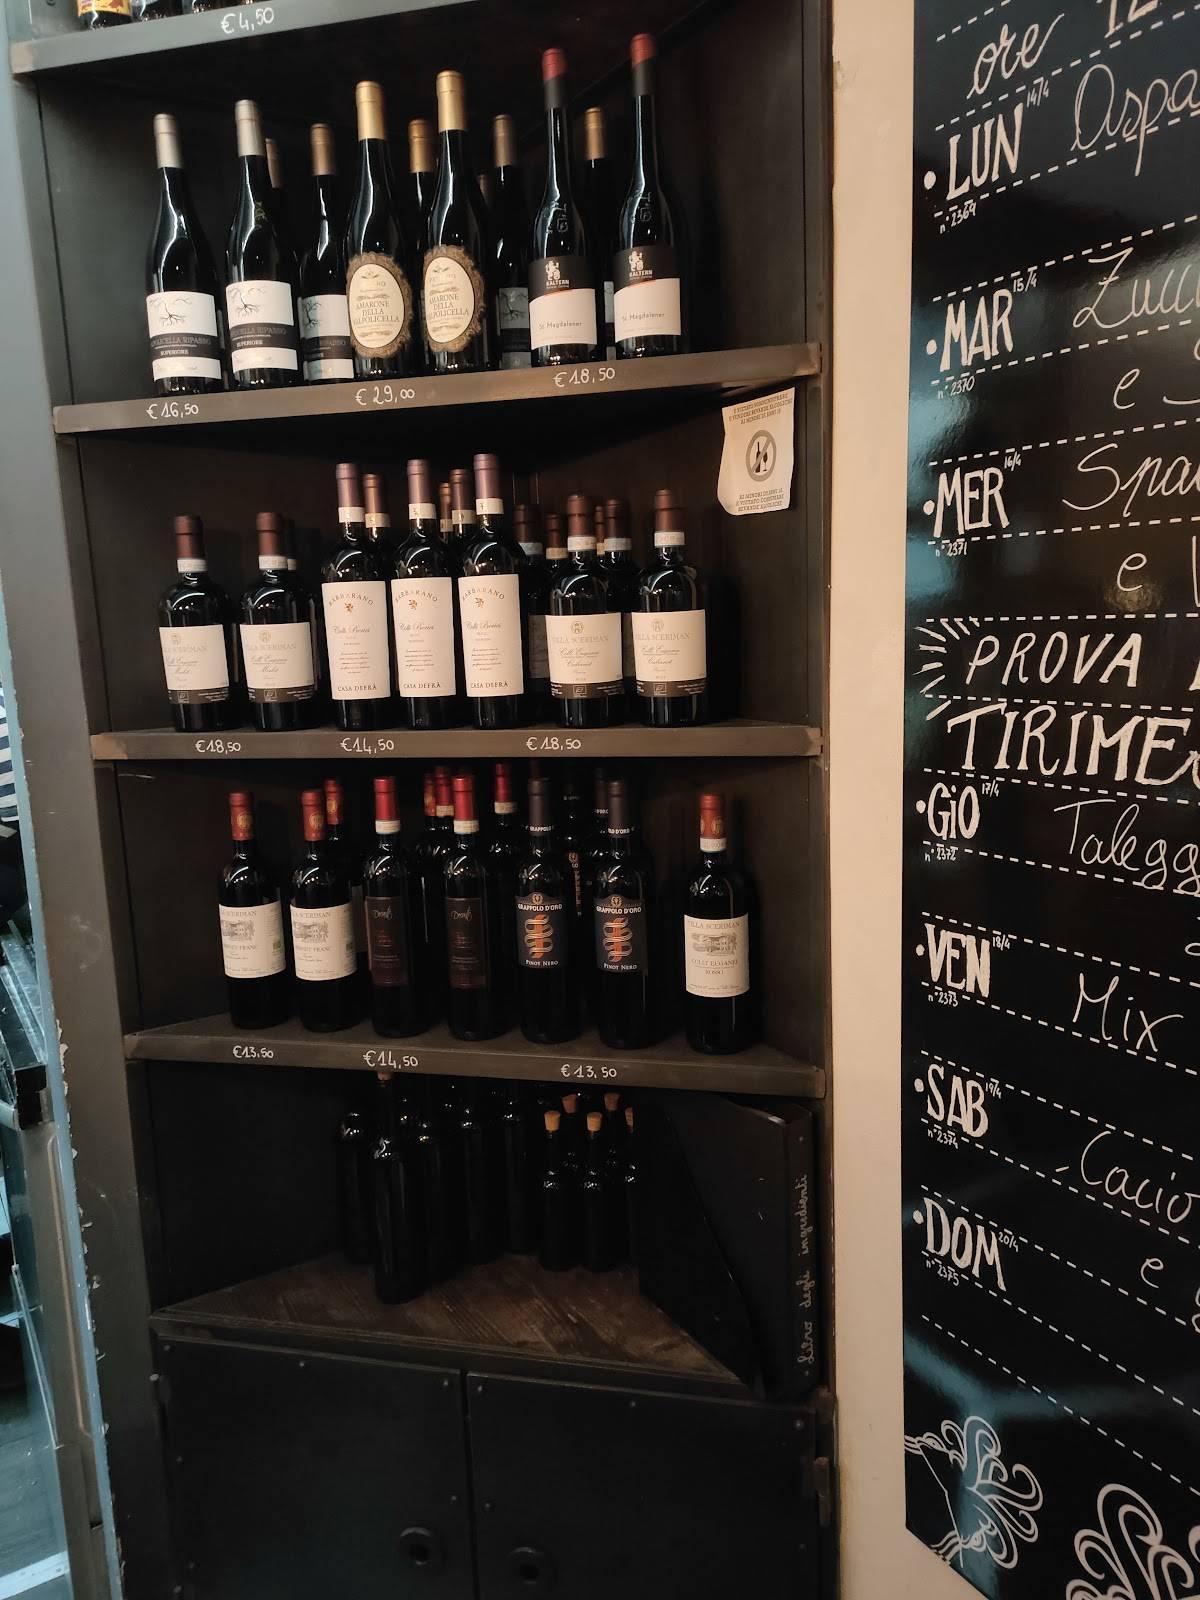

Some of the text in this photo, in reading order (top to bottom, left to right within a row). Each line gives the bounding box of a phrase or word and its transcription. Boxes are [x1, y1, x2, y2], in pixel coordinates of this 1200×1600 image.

[967, 13, 1065, 99] ore
[946, 103, 1024, 200] LUN
[939, 272, 1037, 372] MAR 15/4
[1113, 368, 1140, 409] e
[933, 467, 1010, 538] MER
[1116, 552, 1147, 592] e
[966, 631, 1143, 687] PROVA
[947, 702, 1200, 791] TIRIME
[981, 779, 999, 797] 17/4
[518, 903, 544, 912] GRAPPOLO
[596, 906, 622, 914] GRAPPOLO
[924, 923, 1010, 997] VEN 18/4
[1072, 972, 1184, 1052] Mix
[927, 1063, 1001, 1138] SAB 19/4
[1081, 1130, 1200, 1223] Cacio
[923, 1197, 1019, 1291] DOM 20/4
[1140, 1258, 1164, 1288] e
